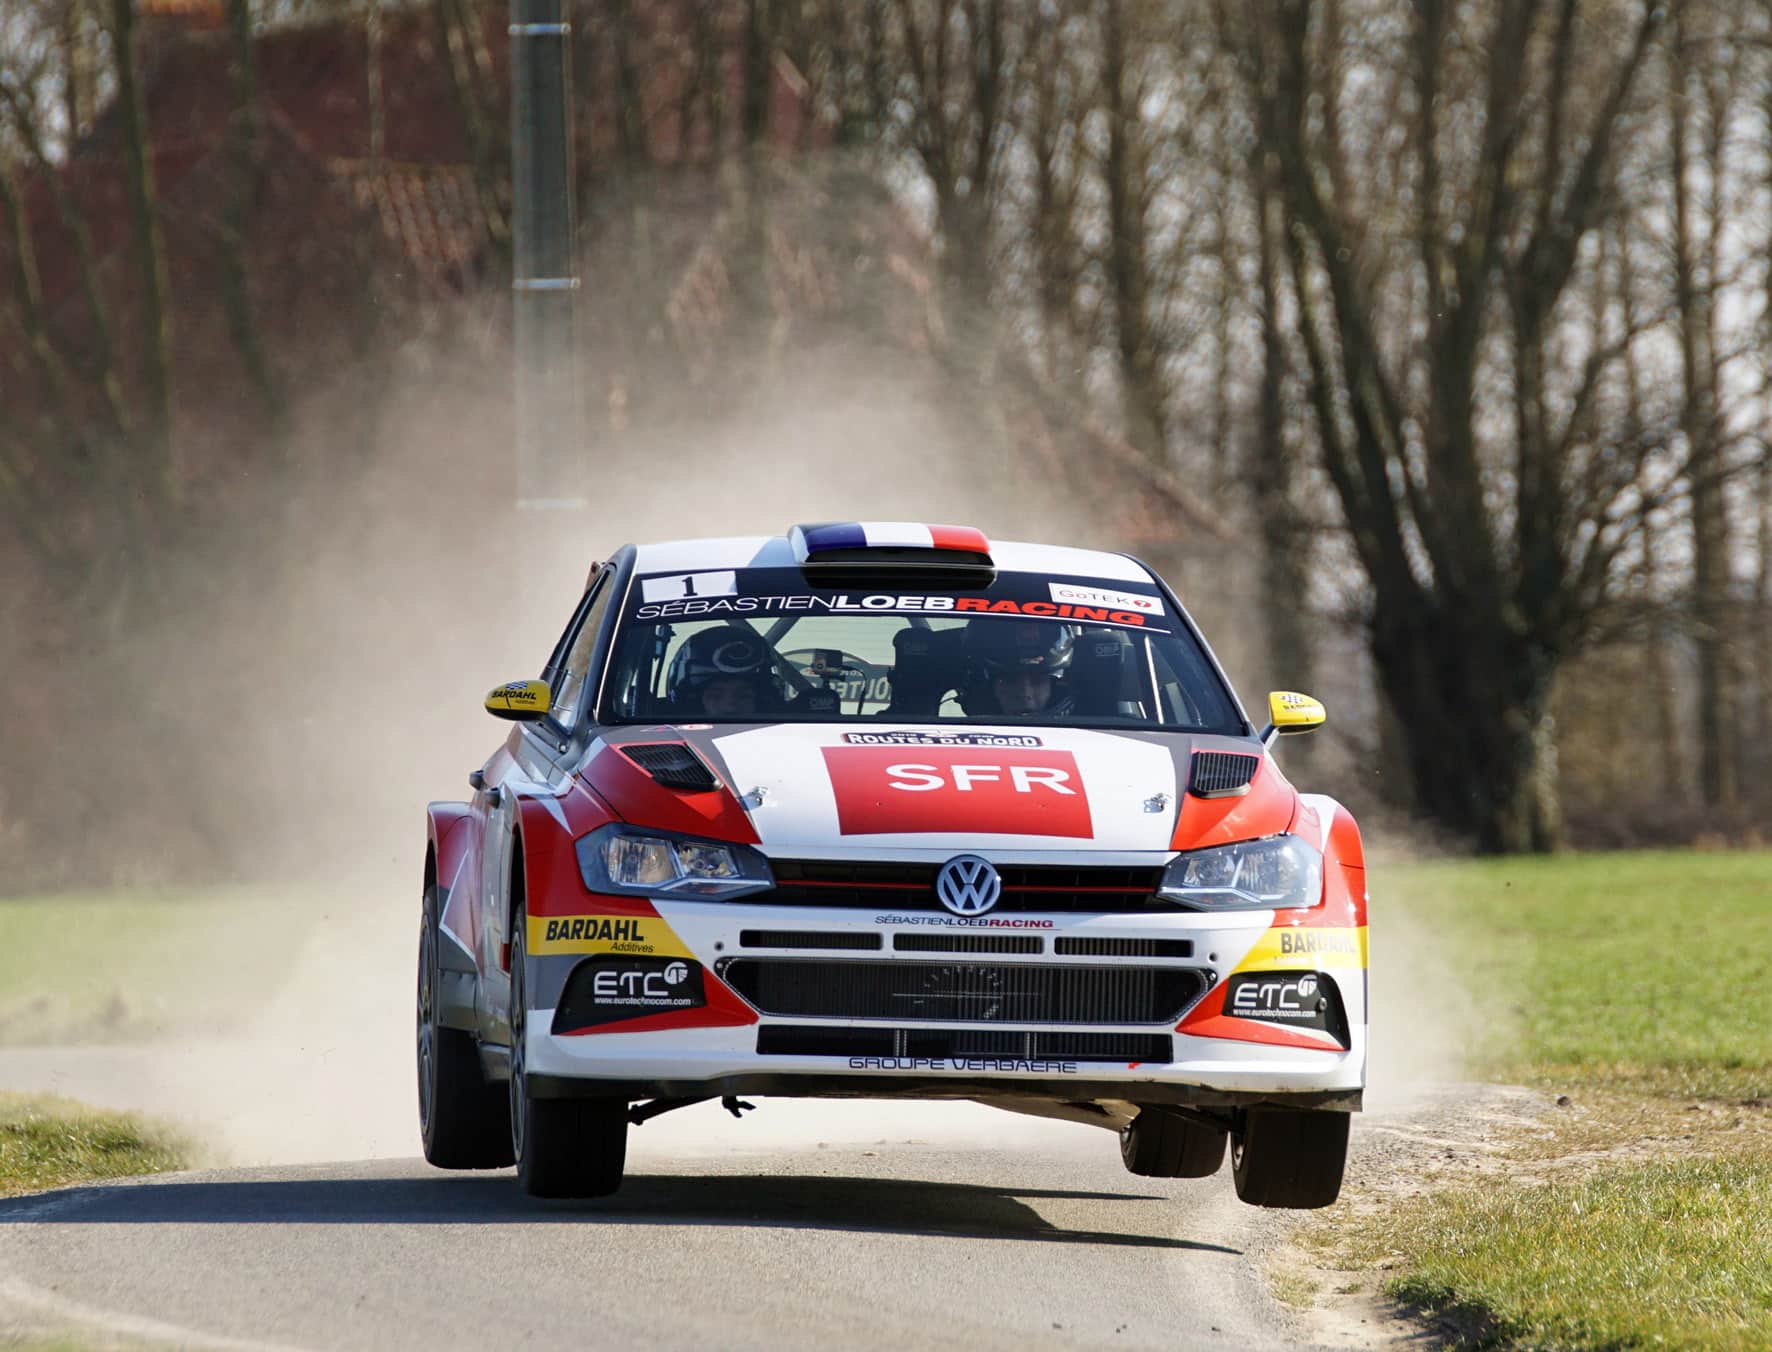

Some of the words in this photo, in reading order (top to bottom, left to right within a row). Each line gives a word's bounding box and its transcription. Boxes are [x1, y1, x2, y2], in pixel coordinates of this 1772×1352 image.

[681, 576, 699, 597] 1
[848, 732, 933, 745] ROUTES
[939, 736, 971, 746] DU
[977, 737, 1037, 748] NORD
[885, 763, 1077, 795] SFR
[545, 919, 645, 941] BARDAHL
[611, 941, 654, 953] Additives
[594, 971, 669, 996] ETC
[1234, 983, 1300, 1008] ETC
[849, 1057, 945, 1070] GROUPE
[952, 1058, 1077, 1074] VERBAERE
